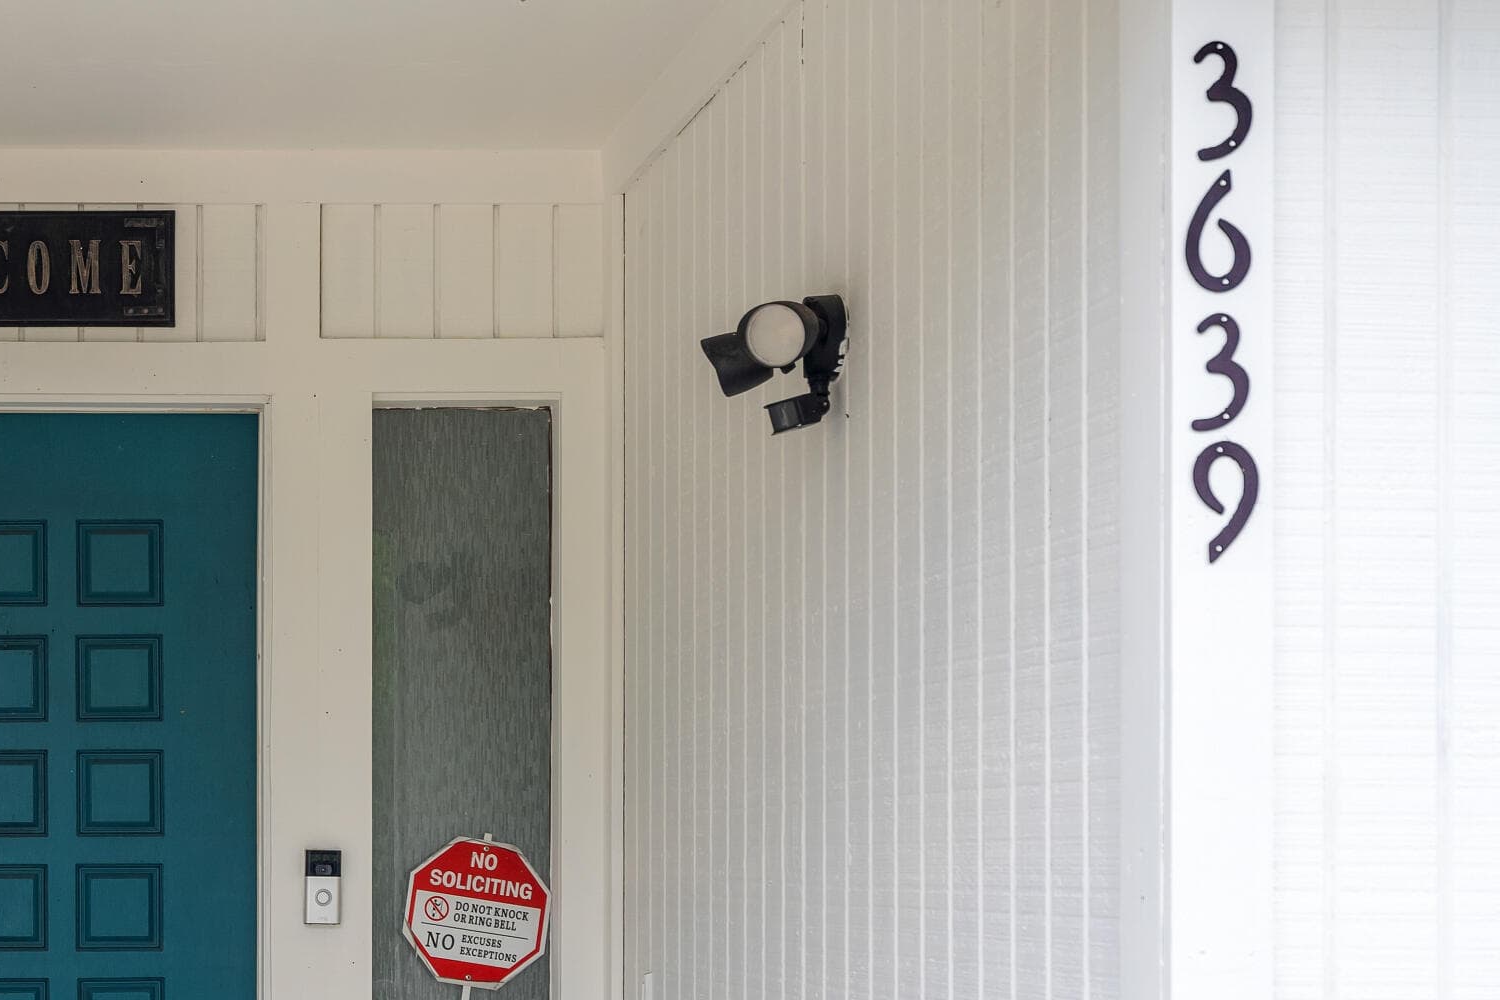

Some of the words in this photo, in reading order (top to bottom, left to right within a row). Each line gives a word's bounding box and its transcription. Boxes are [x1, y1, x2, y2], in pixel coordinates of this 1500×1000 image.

[1184, 41, 1258, 563] 3639
[470, 851, 498, 871] NO
[429, 868, 533, 900] SOLICITING
[455, 901, 470, 912] DO
[471, 904, 492, 915] NOT
[493, 907, 529, 921] KNOCK
[453, 913, 467, 924] OR
[468, 914, 493, 927] RING
[493, 918, 517, 931] BELL
[425, 931, 455, 950] NO
[461, 935, 502, 948] EXCUSES
[459, 946, 517, 963] EXCEPTIONS
